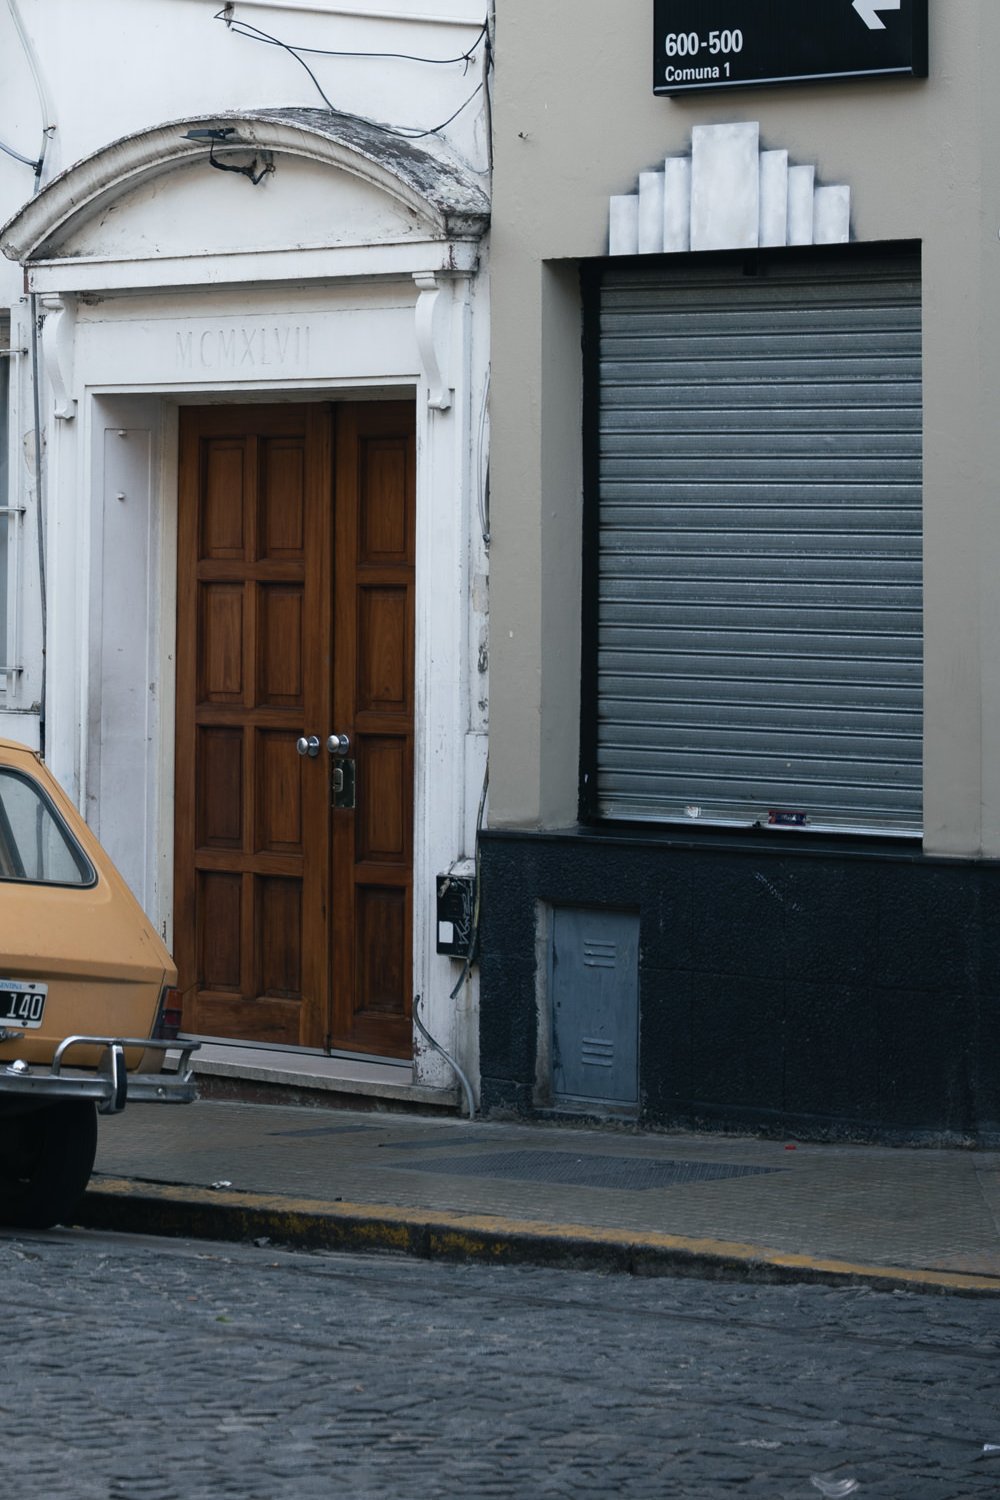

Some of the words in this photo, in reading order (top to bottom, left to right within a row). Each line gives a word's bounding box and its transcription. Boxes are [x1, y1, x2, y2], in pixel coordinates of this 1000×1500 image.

[665, 29, 743, 56] 600-500
[665, 65, 720, 82] Comuna
[723, 61, 730, 77] 1
[176, 326, 310, 368] MCMXLVII
[6, 993, 43, 1020] 140
